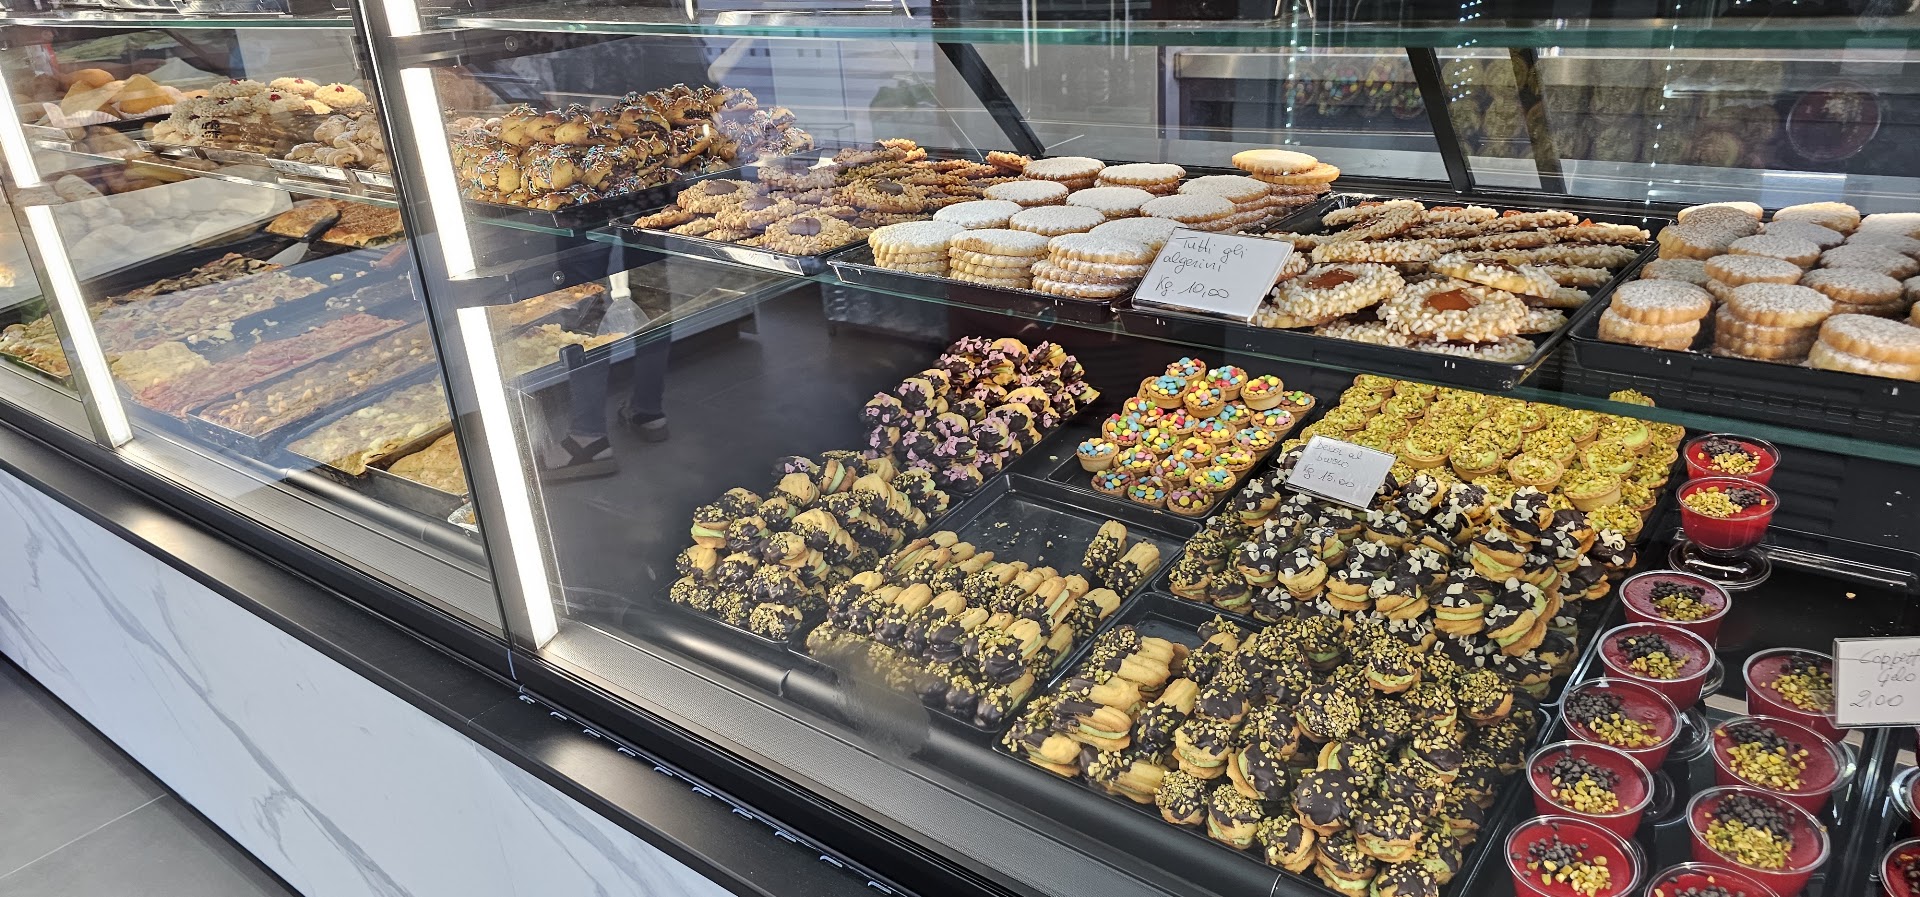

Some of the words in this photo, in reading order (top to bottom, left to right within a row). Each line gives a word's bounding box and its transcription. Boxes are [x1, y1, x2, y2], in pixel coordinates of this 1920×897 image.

[1175, 237, 1217, 255] Tutti
[1220, 243, 1248, 263] gli
[1163, 251, 1222, 274] algerini
[1178, 281, 1230, 298] 10,00
[1318, 470, 1355, 487] 15,00
